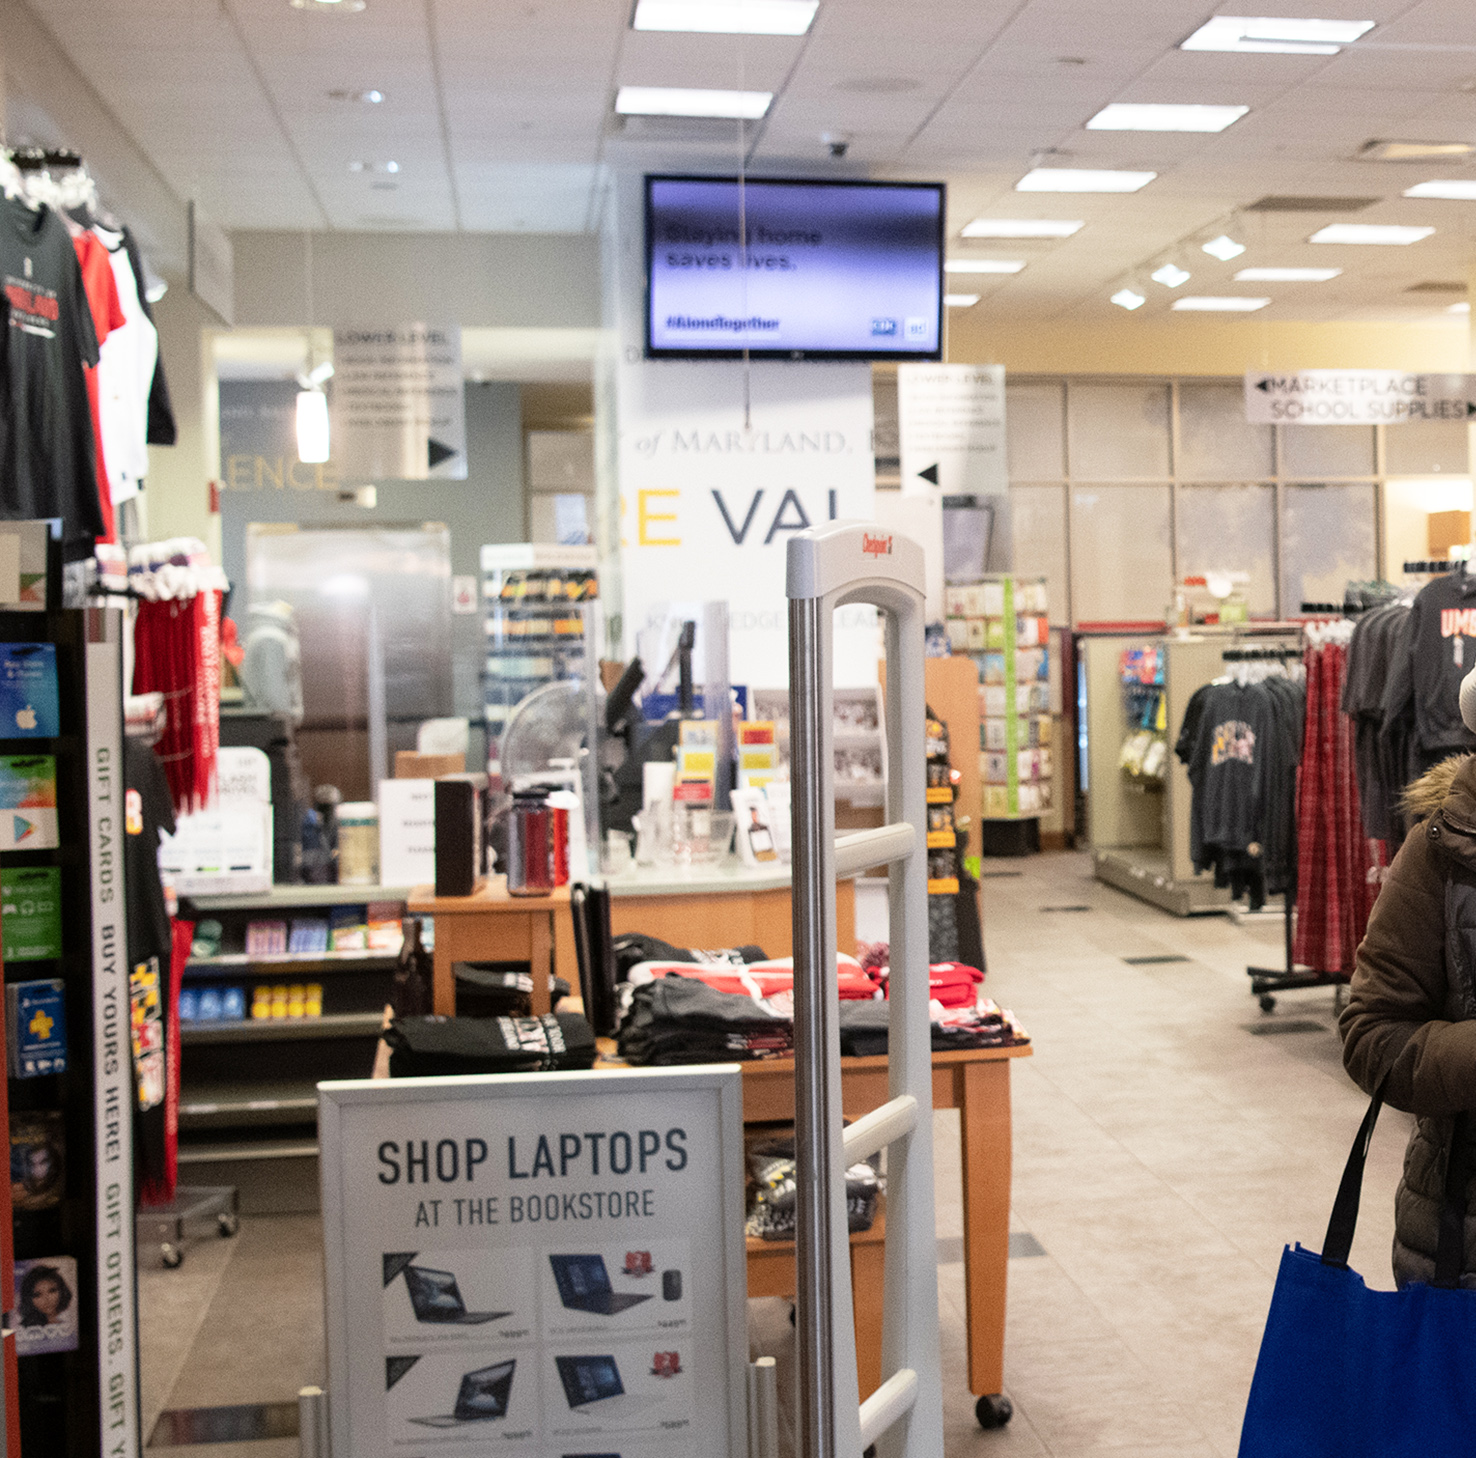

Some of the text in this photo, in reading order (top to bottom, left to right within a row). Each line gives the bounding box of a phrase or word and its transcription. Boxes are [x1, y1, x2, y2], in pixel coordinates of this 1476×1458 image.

[666, 251, 798, 270] saves ives.
[757, 225, 823, 245] home
[335, 330, 450, 346] LOWER LEVEL
[1270, 376, 1427, 396] MARKETPLACE
[1271, 400, 1464, 420] SCHOOL SUPPLIES
[97, 747, 111, 803] GIFT
[98, 816, 113, 904] CARDS
[101, 924, 116, 975] BUY
[103, 986, 119, 1076] YOURS
[105, 1086, 121, 1163] HERE!
[377, 1127, 688, 1185] SHOP LAPTOPS
[106, 1183, 121, 1239] GIFT
[415, 1188, 655, 1229] AT THE BOOKSTORE
[109, 1372, 125, 1429] GIFT
